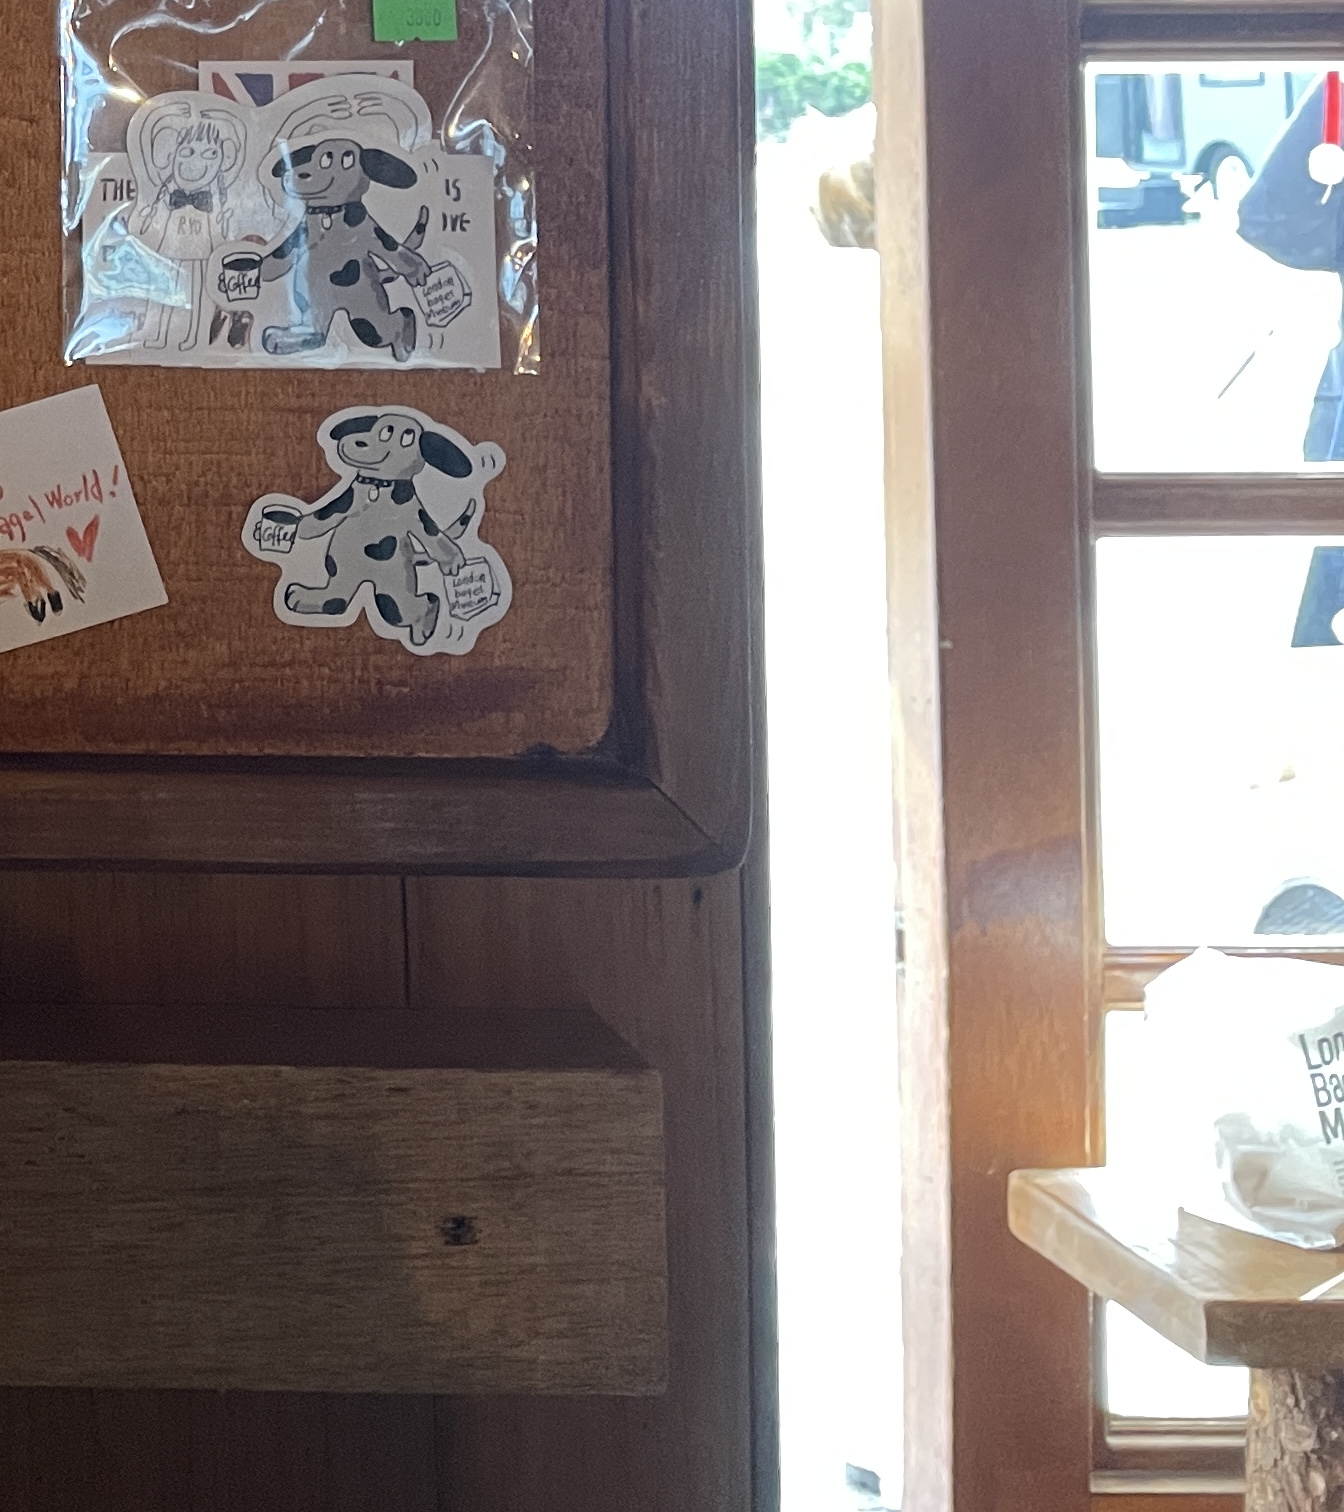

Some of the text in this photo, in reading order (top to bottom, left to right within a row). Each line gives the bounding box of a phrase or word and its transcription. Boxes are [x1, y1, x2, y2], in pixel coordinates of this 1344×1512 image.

[101, 178, 461, 202] THE IS
[261, 524, 296, 545] Coffee
